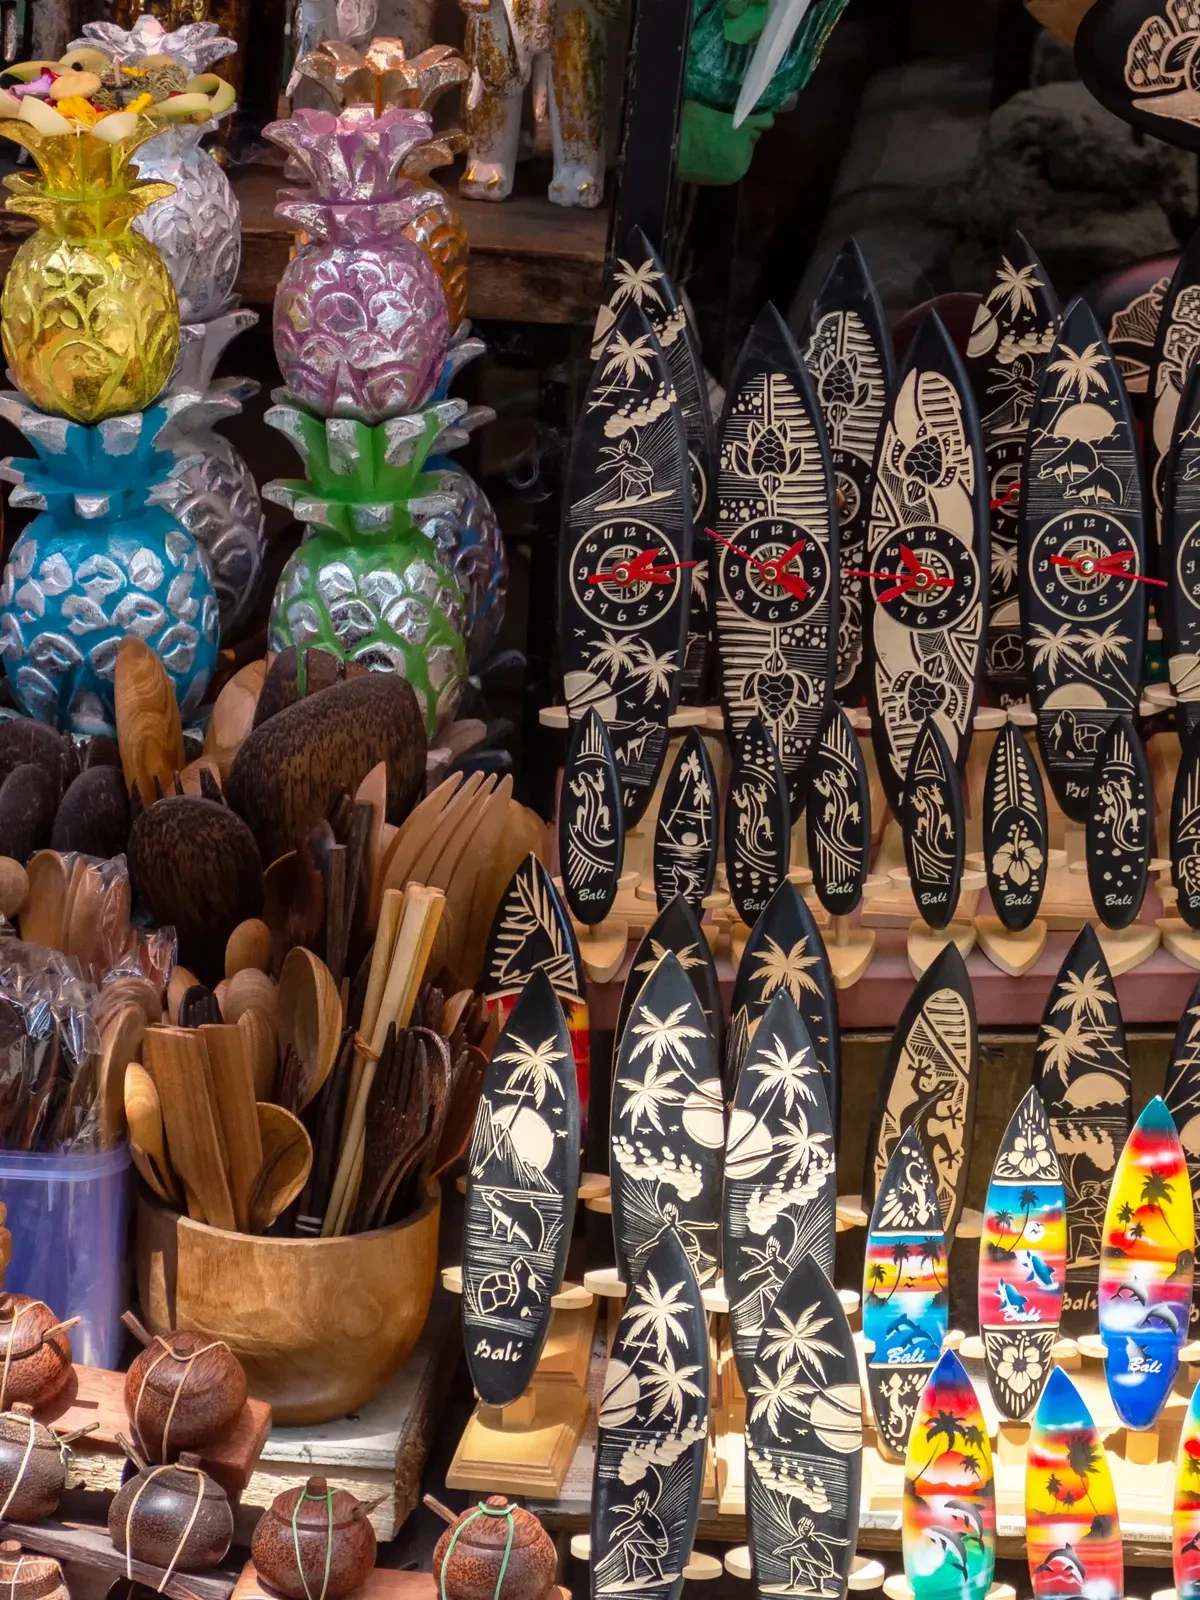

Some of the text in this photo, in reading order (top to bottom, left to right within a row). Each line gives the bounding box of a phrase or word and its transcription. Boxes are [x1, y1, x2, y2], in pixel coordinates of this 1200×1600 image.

[1063, 521, 1073, 531] 11
[1083, 519, 1095, 529] 12
[1104, 524, 1110, 532] 1
[604, 528, 613, 539] 11
[624, 527, 636, 537] 12
[750, 529, 759, 539] 11
[771, 525, 783, 535] 12
[792, 529, 797, 538] 1
[646, 532, 651, 541] 1
[906, 532, 915, 541] 11
[925, 531, 937, 541] 12
[1044, 536, 1057, 545] 10
[805, 542, 816, 552] 2
[948, 538, 954, 547] 1
[1117, 538, 1127, 546] 2
[586, 543, 598, 553] 10
[886, 547, 899, 557] 10
[960, 551, 969, 560] 2
[1038, 559, 1049, 572] 9
[1187, 560, 1196, 574] 9
[577, 566, 588, 580] 9
[729, 565, 740, 578] 9
[812, 566, 821, 578] 3
[963, 575, 972, 586] 3
[1046, 582, 1055, 593] 8
[1116, 581, 1125, 592] 4
[584, 589, 595, 601] 8
[655, 590, 664, 601] 4
[735, 589, 745, 600] 8
[957, 593, 966, 606] 4
[1078, 599, 1087, 612] 6
[1098, 595, 1108, 606] 5
[638, 604, 649, 616] 5
[790, 602, 800, 612] 5
[617, 610, 627, 621] 6
[769, 607, 779, 619] 6
[917, 612, 927, 624] 6
[937, 609, 948, 619] 5
[825, 881, 854, 895] Bali
[578, 888, 607, 901] Bali
[920, 892, 948, 905] Bali
[1004, 893, 1033, 907] Bali
[1104, 893, 1133, 907] Bali
[743, 898, 768, 911] Bal
[1003, 1306, 1042, 1322] Bali
[474, 1339, 523, 1361] Bali
[887, 1345, 926, 1364] Bali
[1129, 1357, 1163, 1374] Bali
